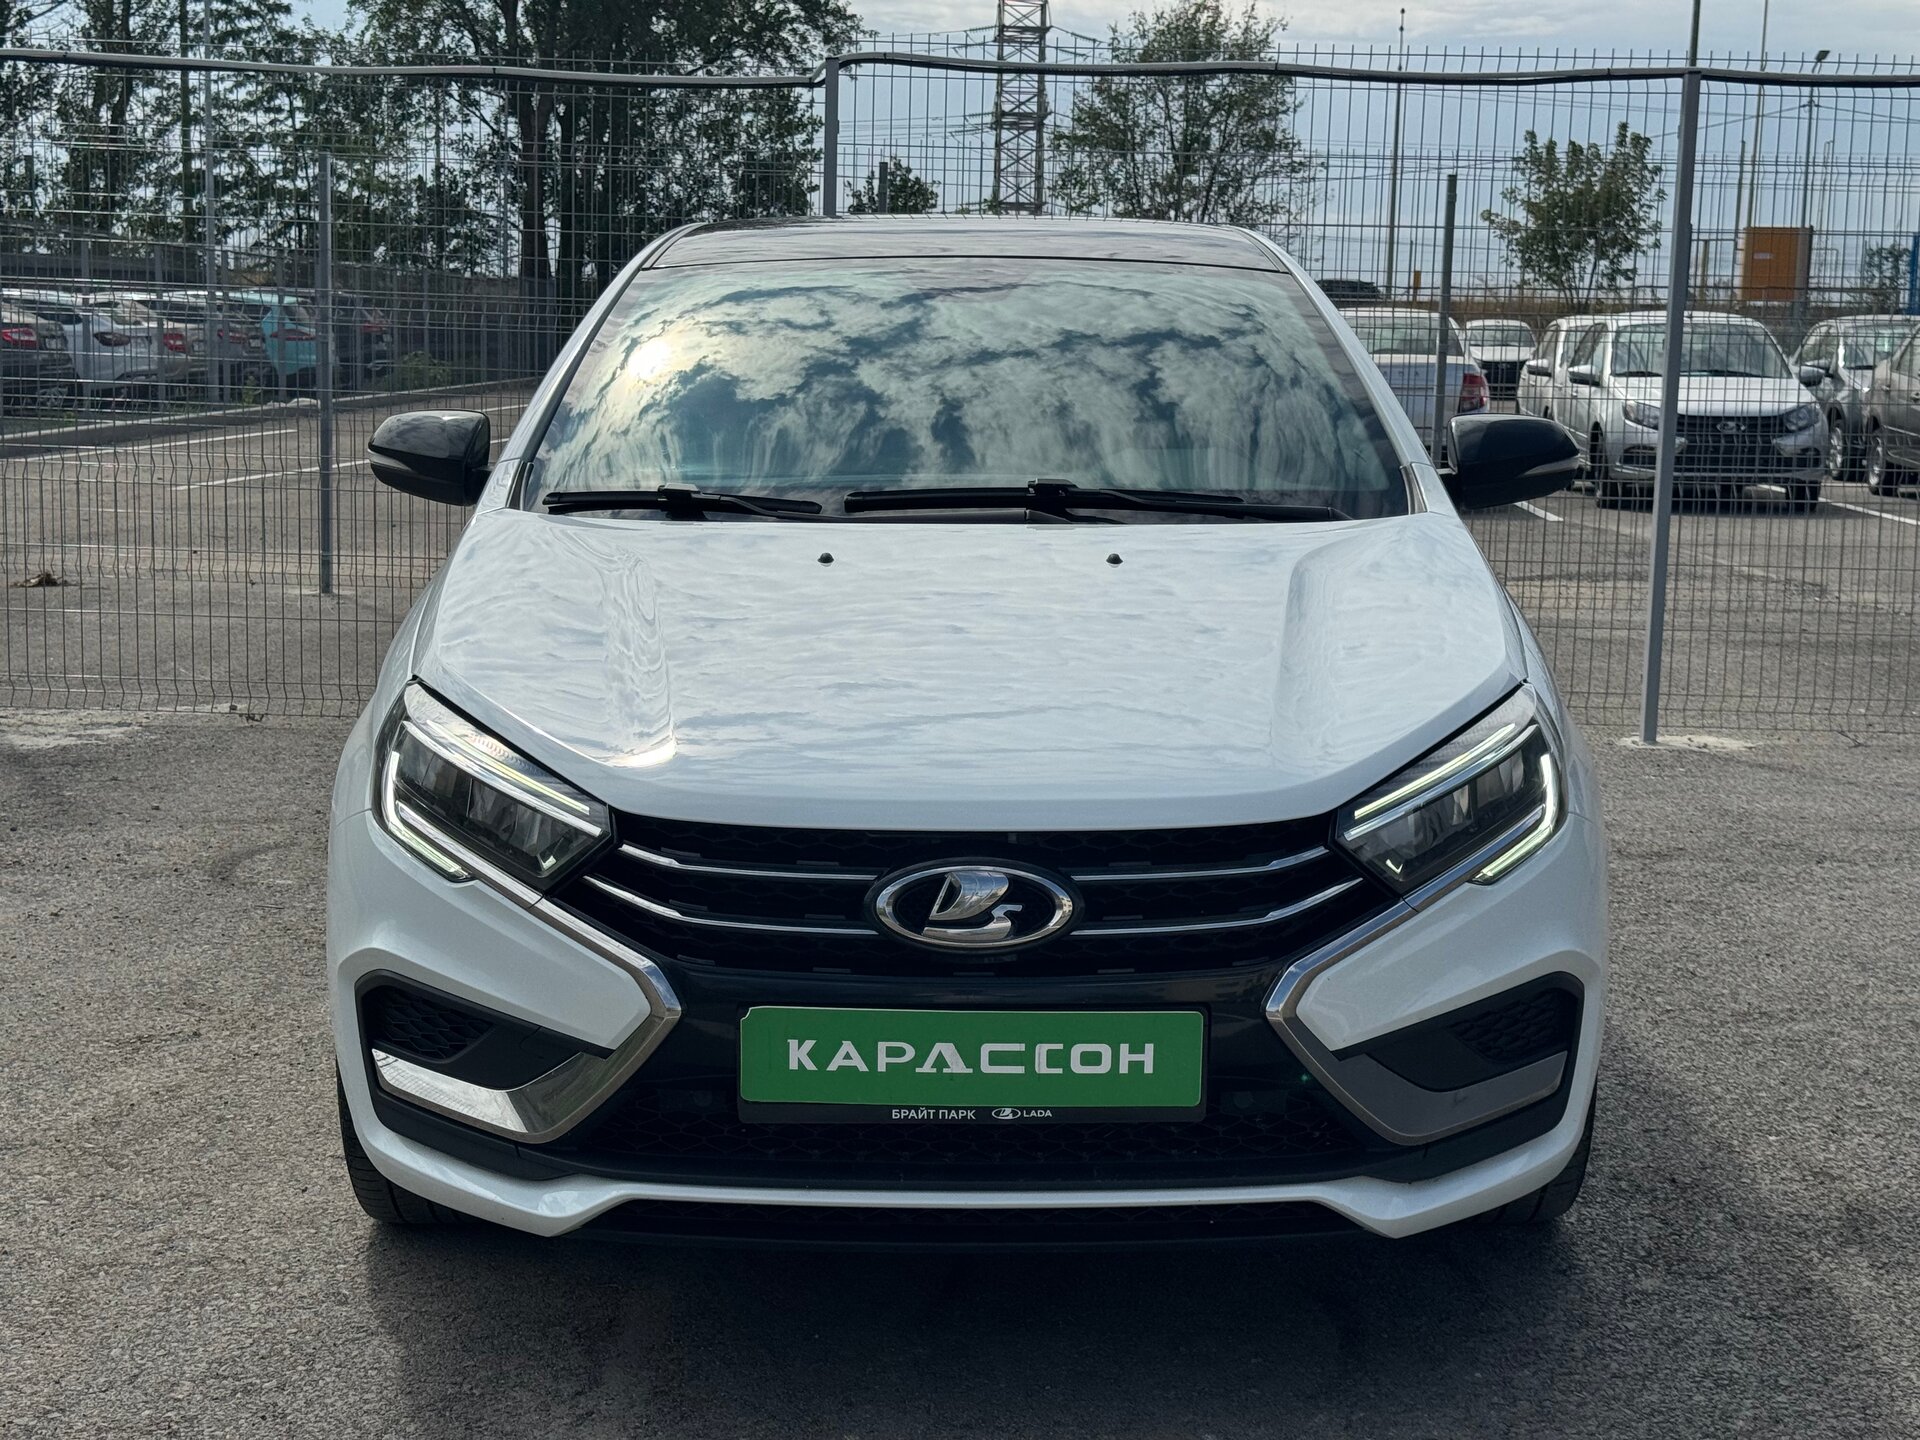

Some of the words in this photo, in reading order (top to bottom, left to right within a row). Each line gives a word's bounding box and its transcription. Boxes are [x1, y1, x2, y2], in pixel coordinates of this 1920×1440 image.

[891, 1107, 936, 1120] БРАЙТ
[938, 1108, 977, 1120] ПАРК
[1023, 1109, 1053, 1118] LADA
